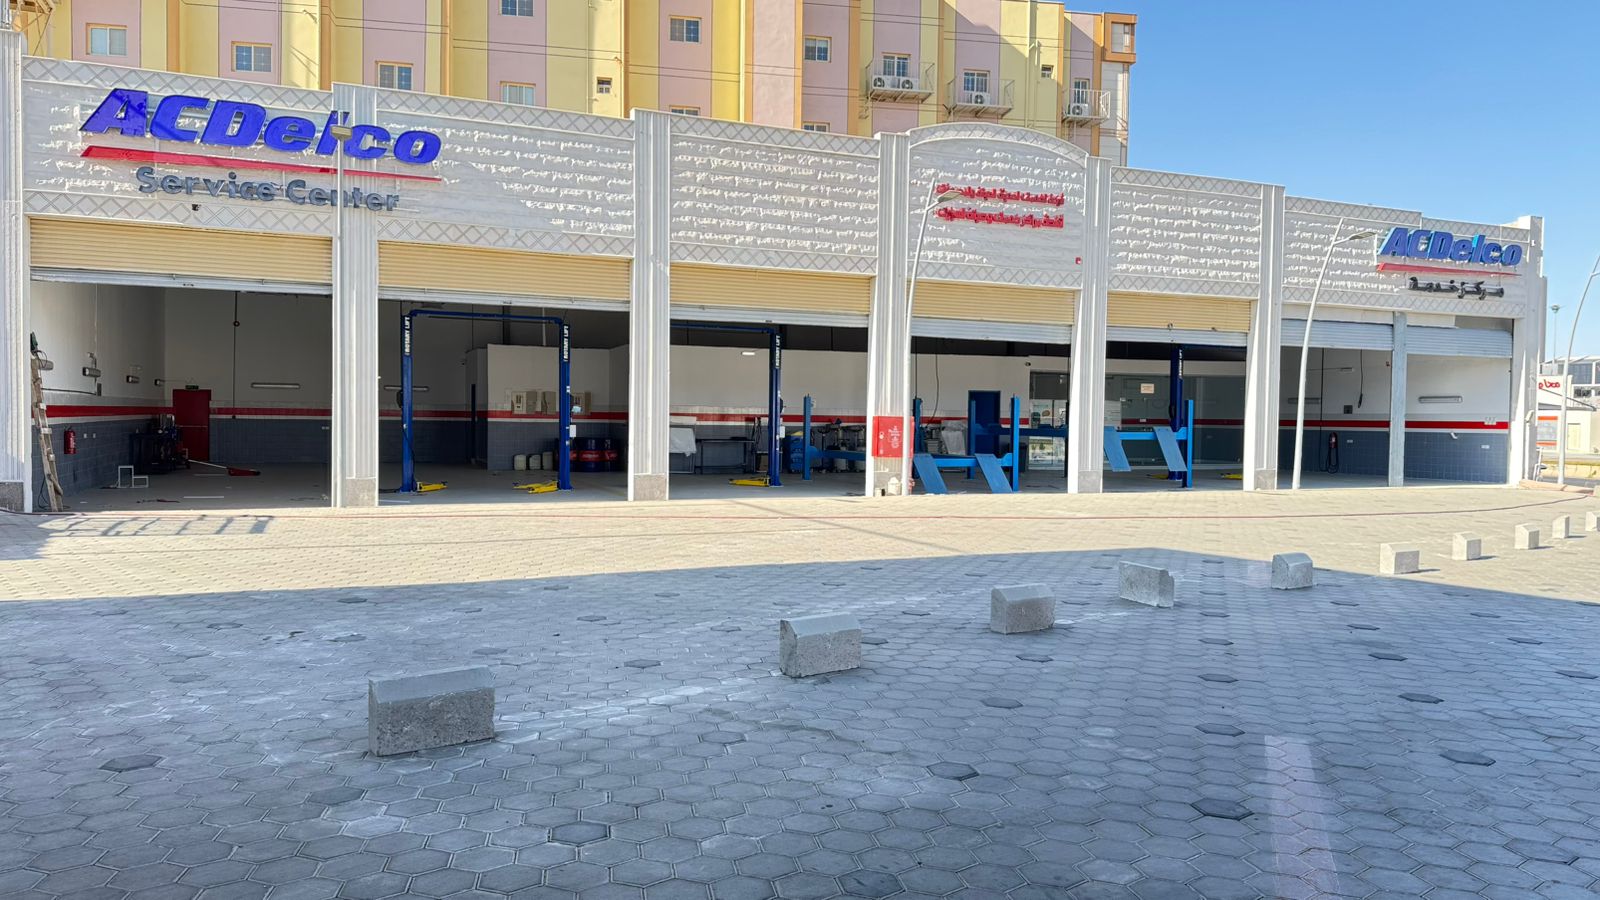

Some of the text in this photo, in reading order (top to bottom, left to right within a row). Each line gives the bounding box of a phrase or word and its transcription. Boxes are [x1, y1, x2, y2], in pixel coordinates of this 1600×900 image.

[80, 87, 441, 164] ACDelco
[136, 166, 400, 211] Service Center
[1377, 227, 1523, 266] ACDelco
